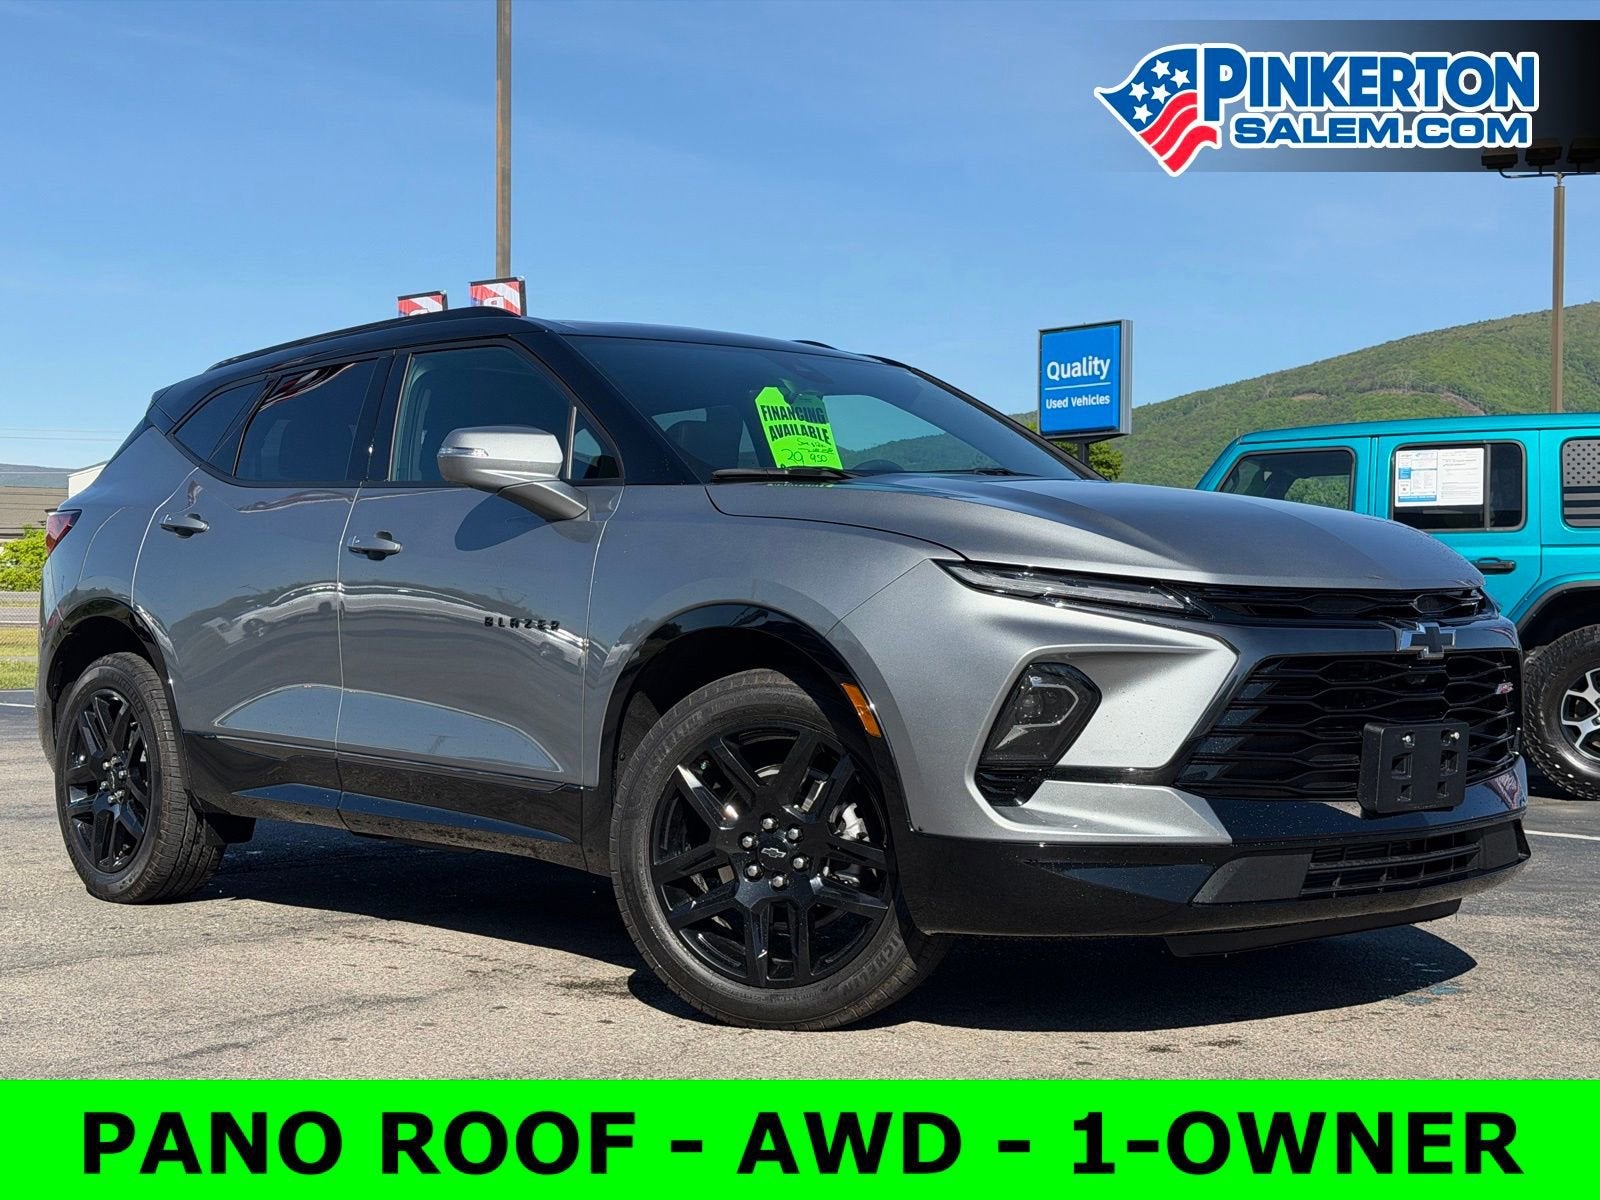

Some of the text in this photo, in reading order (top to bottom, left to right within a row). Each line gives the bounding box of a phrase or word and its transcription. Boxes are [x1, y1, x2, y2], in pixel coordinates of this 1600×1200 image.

[1046, 355, 1111, 381] Quality
[1045, 394, 1111, 410] Used Vehicles
[760, 404, 828, 425] FINANCING
[768, 423, 832, 446] AVAILABLE
[484, 616, 561, 631] BLAZER
